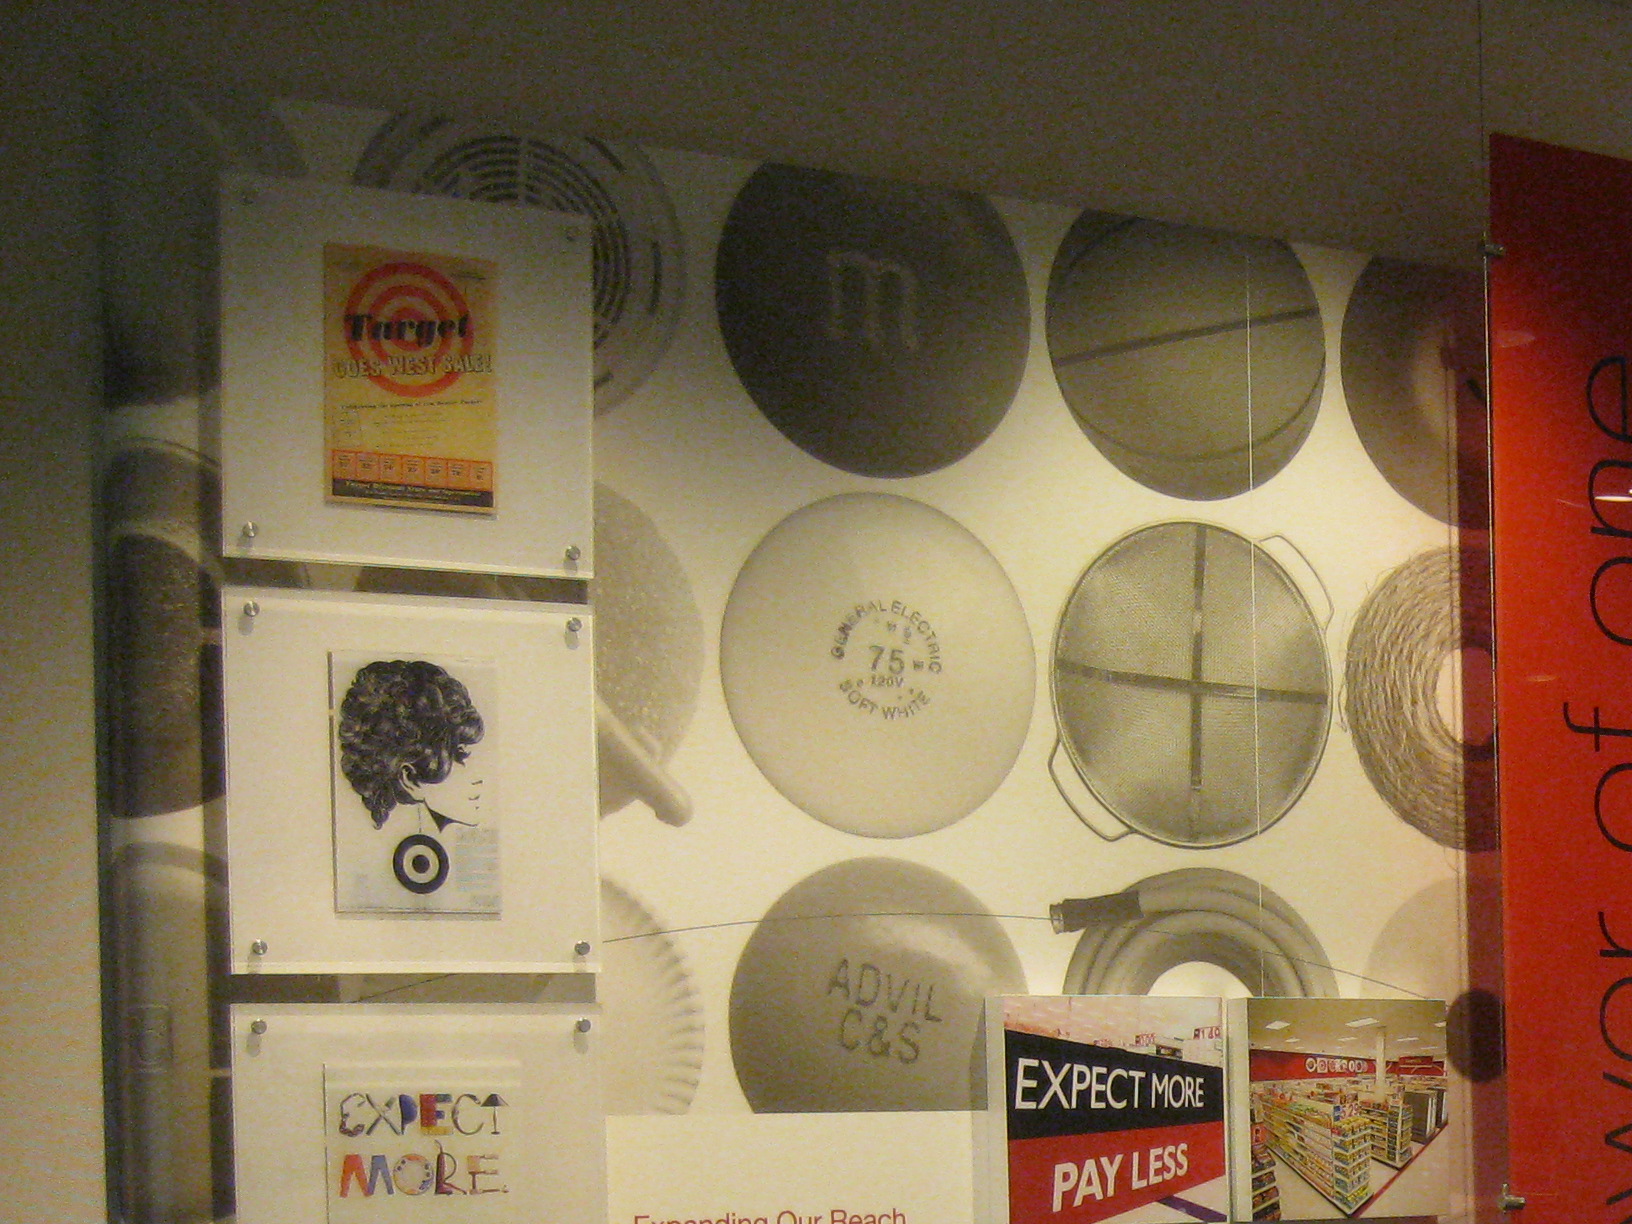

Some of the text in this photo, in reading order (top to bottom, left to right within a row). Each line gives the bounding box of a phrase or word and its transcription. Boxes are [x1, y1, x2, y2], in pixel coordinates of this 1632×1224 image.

[344, 313, 469, 347] Target
[869, 645, 905, 675] 75
[890, 600, 942, 674] ELECTRIC
[840, 680, 930, 720] SOFT WHITE
[827, 957, 943, 1025] ADVIL
[836, 1009, 922, 1064] C&S
[1014, 1056, 1205, 1112] EXPECT MORE
[338, 1092, 509, 1137] EXPECT
[1051, 1140, 1189, 1213] PAY LESS
